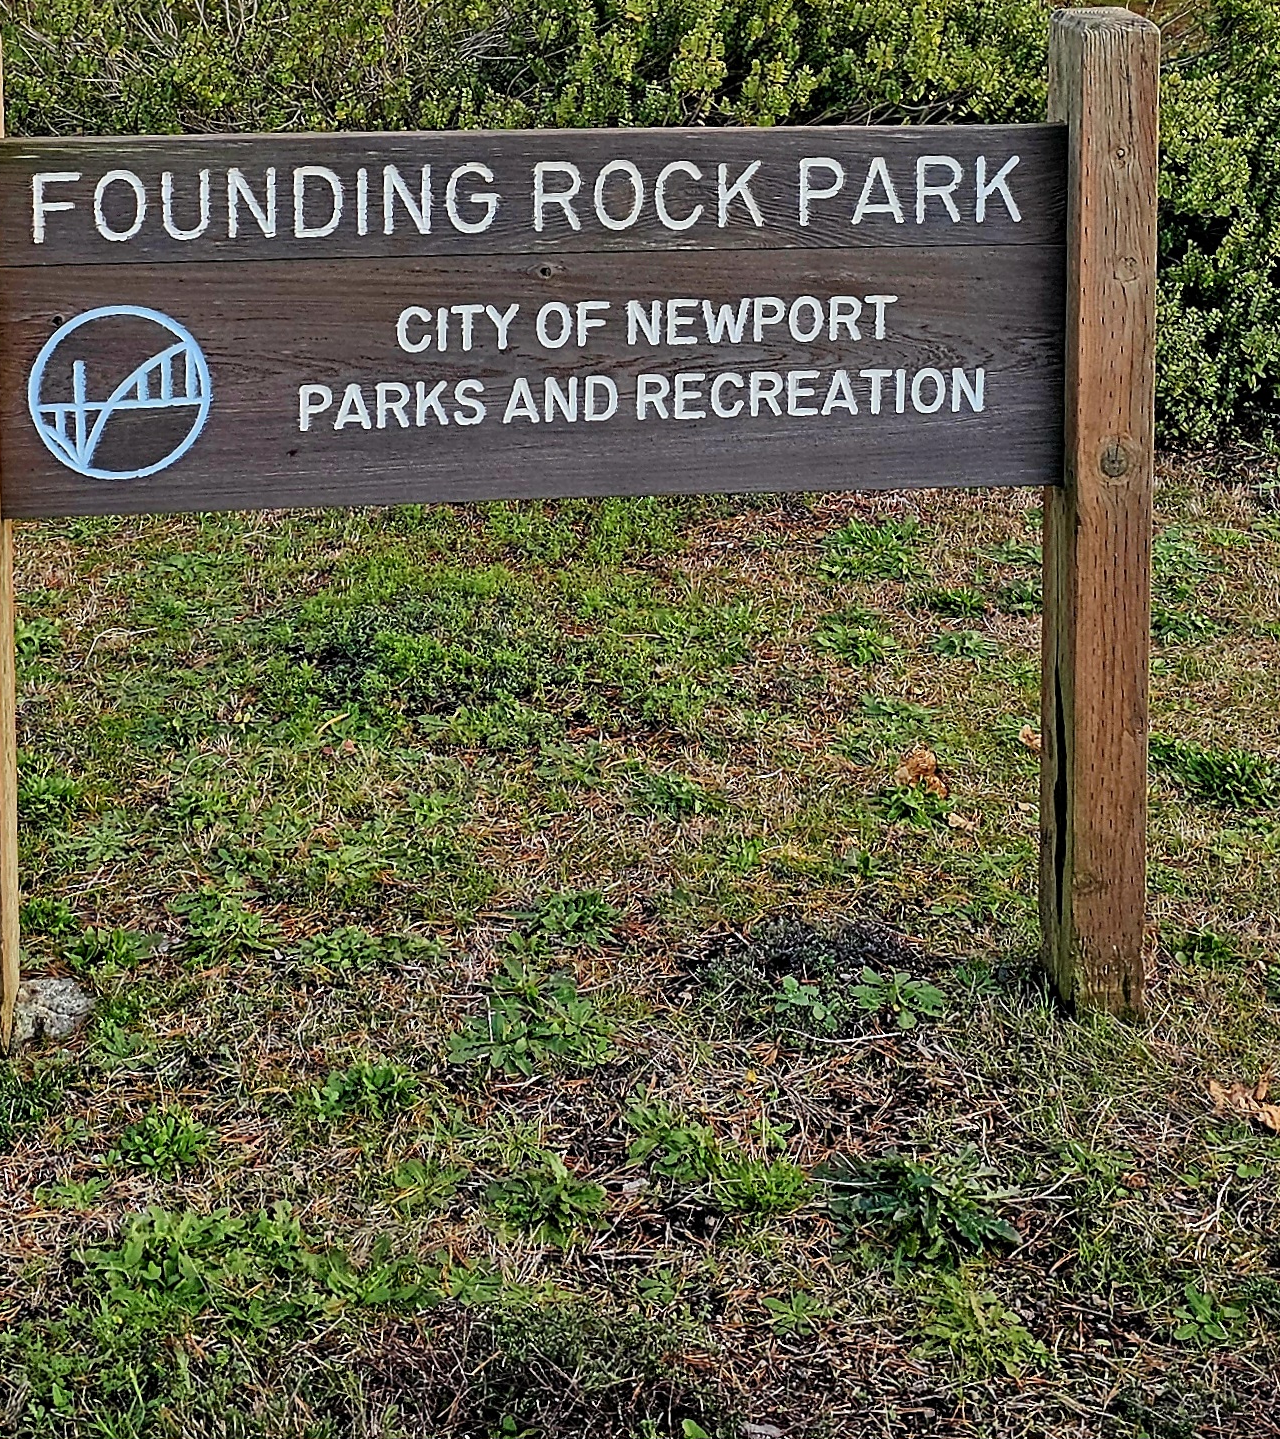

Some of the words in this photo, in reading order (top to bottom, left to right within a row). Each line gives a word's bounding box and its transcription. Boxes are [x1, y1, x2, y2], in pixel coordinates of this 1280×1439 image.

[29, 161, 503, 244] FOUNDING
[530, 159, 768, 232] ROCK
[796, 155, 1023, 227] PARK
[394, 303, 521, 353] CITY
[535, 300, 611, 349] OF
[624, 294, 899, 346] NEWPORT
[297, 378, 487, 432] PARKS
[502, 375, 619, 424] AND
[635, 367, 986, 421] RECREATION
